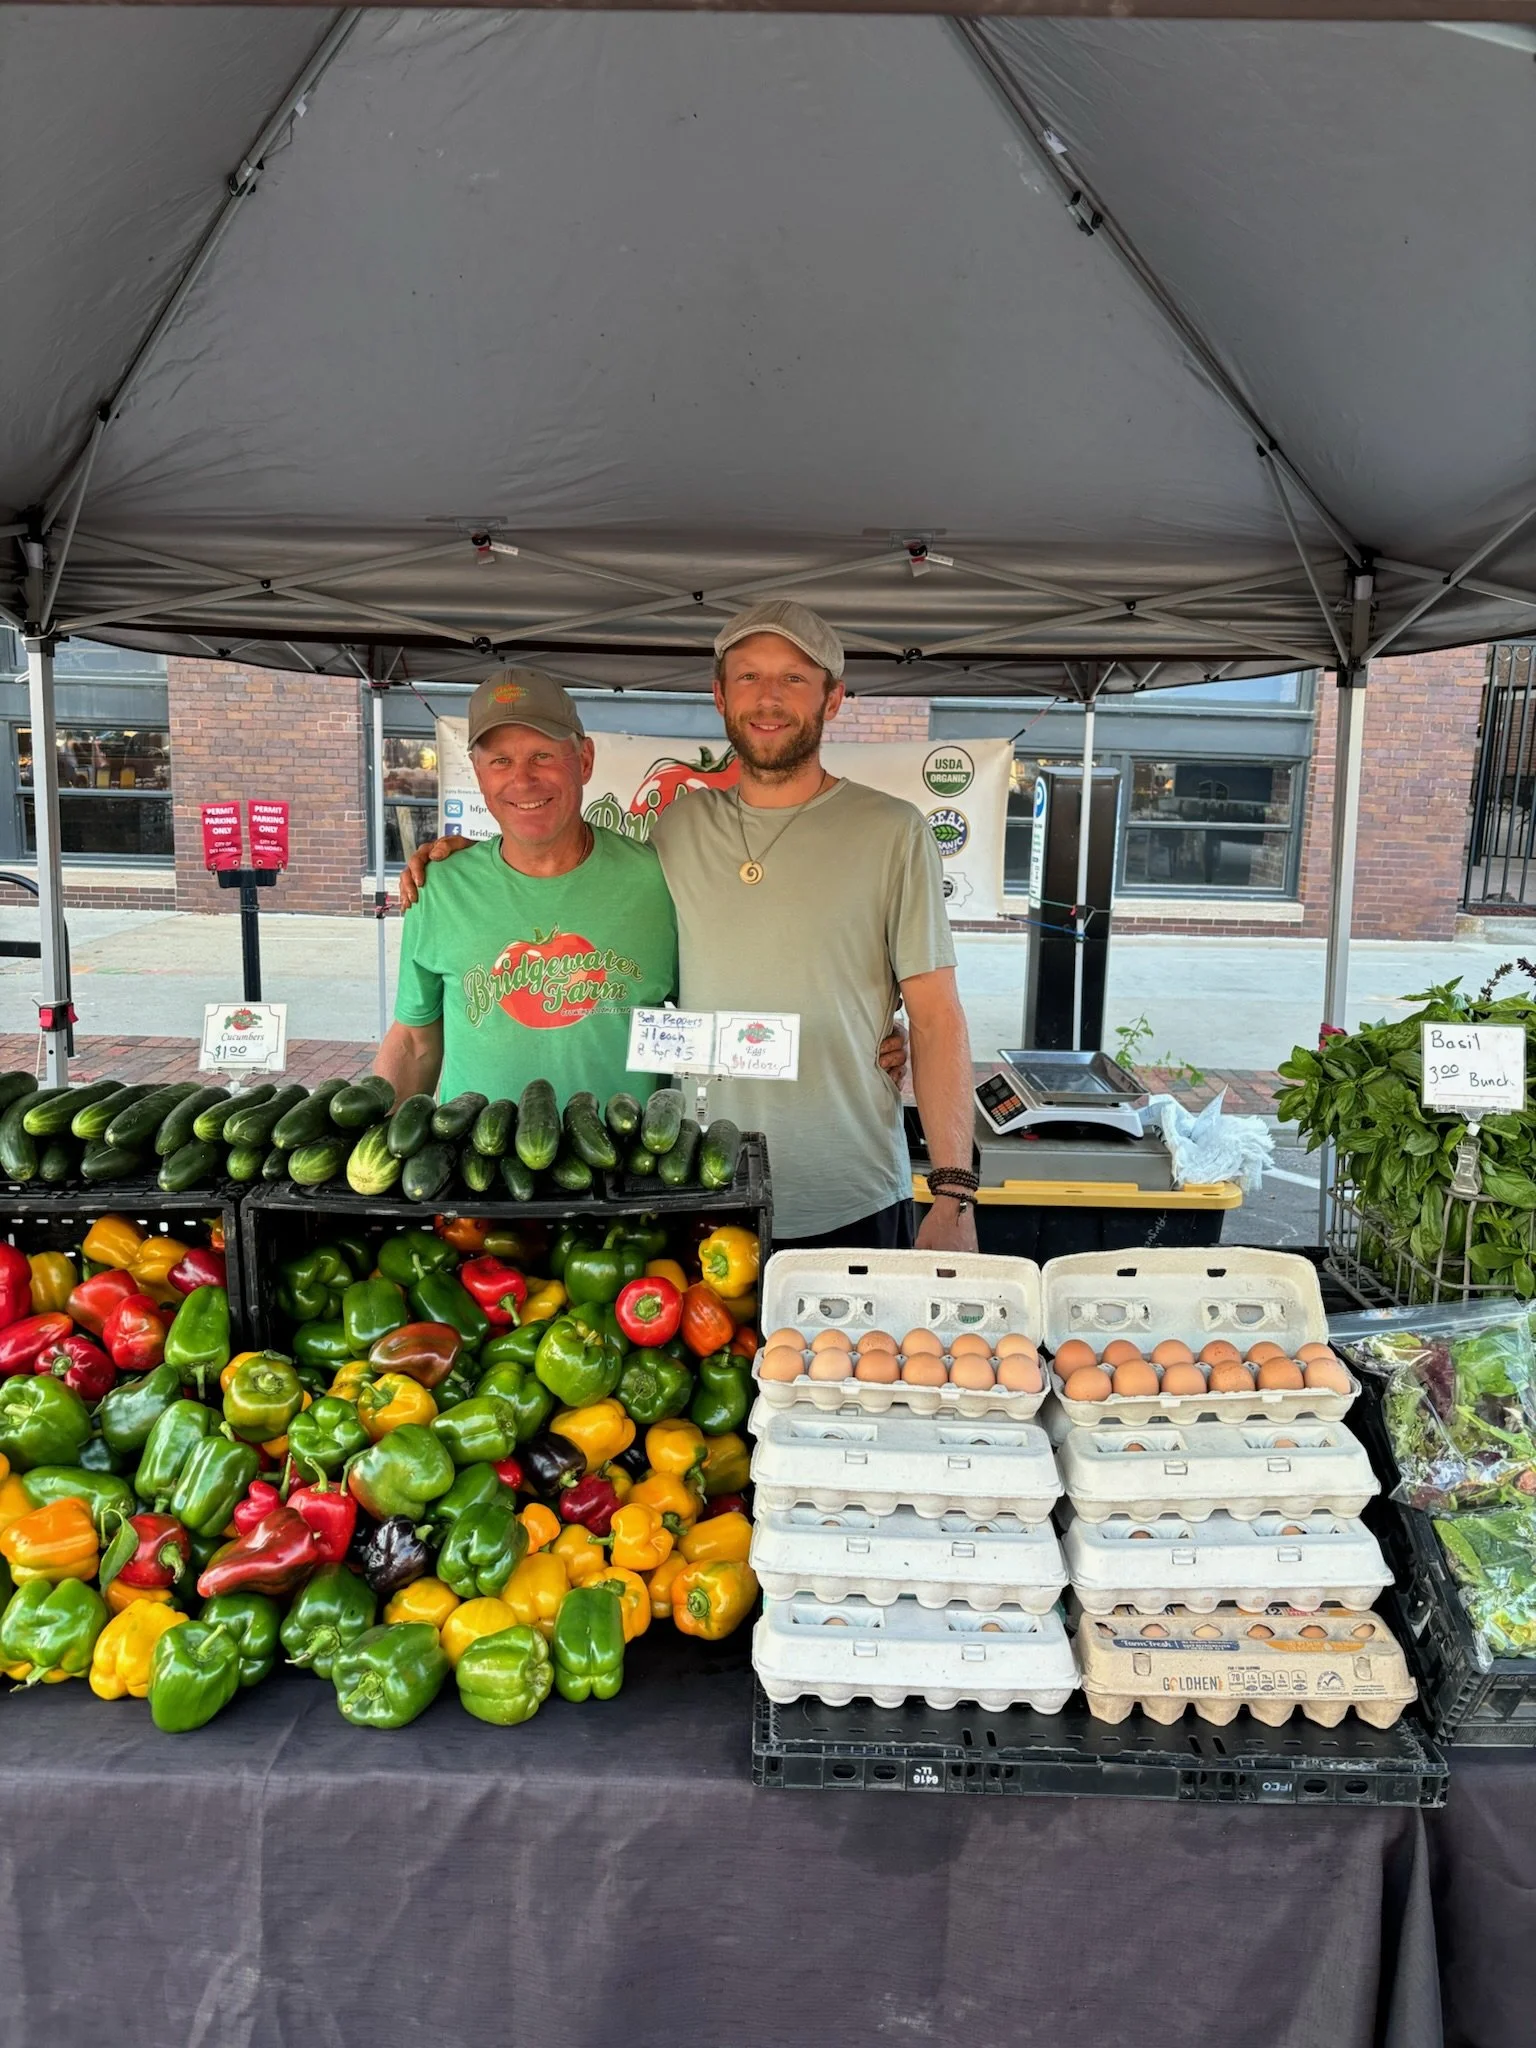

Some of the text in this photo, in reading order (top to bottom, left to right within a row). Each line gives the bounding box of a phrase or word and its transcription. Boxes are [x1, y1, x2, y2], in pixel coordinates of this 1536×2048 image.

[935, 758, 963, 770] USDA
[930, 773, 967, 784] ORGANIC
[206, 807, 234, 815] PERMIT
[254, 805, 283, 814] PERMIT
[205, 817, 237, 825] PARKING
[252, 815, 284, 824] PARKING
[927, 810, 965, 832] REAL
[212, 827, 232, 835] ONLY
[259, 825, 278, 833] ONLY
[463, 949, 644, 1028] Bridgewater
[542, 976, 628, 1014] Farm
[637, 1011, 703, 1031] Bell Peppers
[221, 1031, 264, 1042] Cucumbers
[659, 1031, 685, 1043] each
[1431, 1029, 1481, 1051] Basil
[746, 1046, 767, 1057] Eggs
[1163, 1675, 1217, 1691] GOLDHEN
[913, 1774, 939, 1785] 6416
[1262, 1781, 1293, 1792] IFCO
